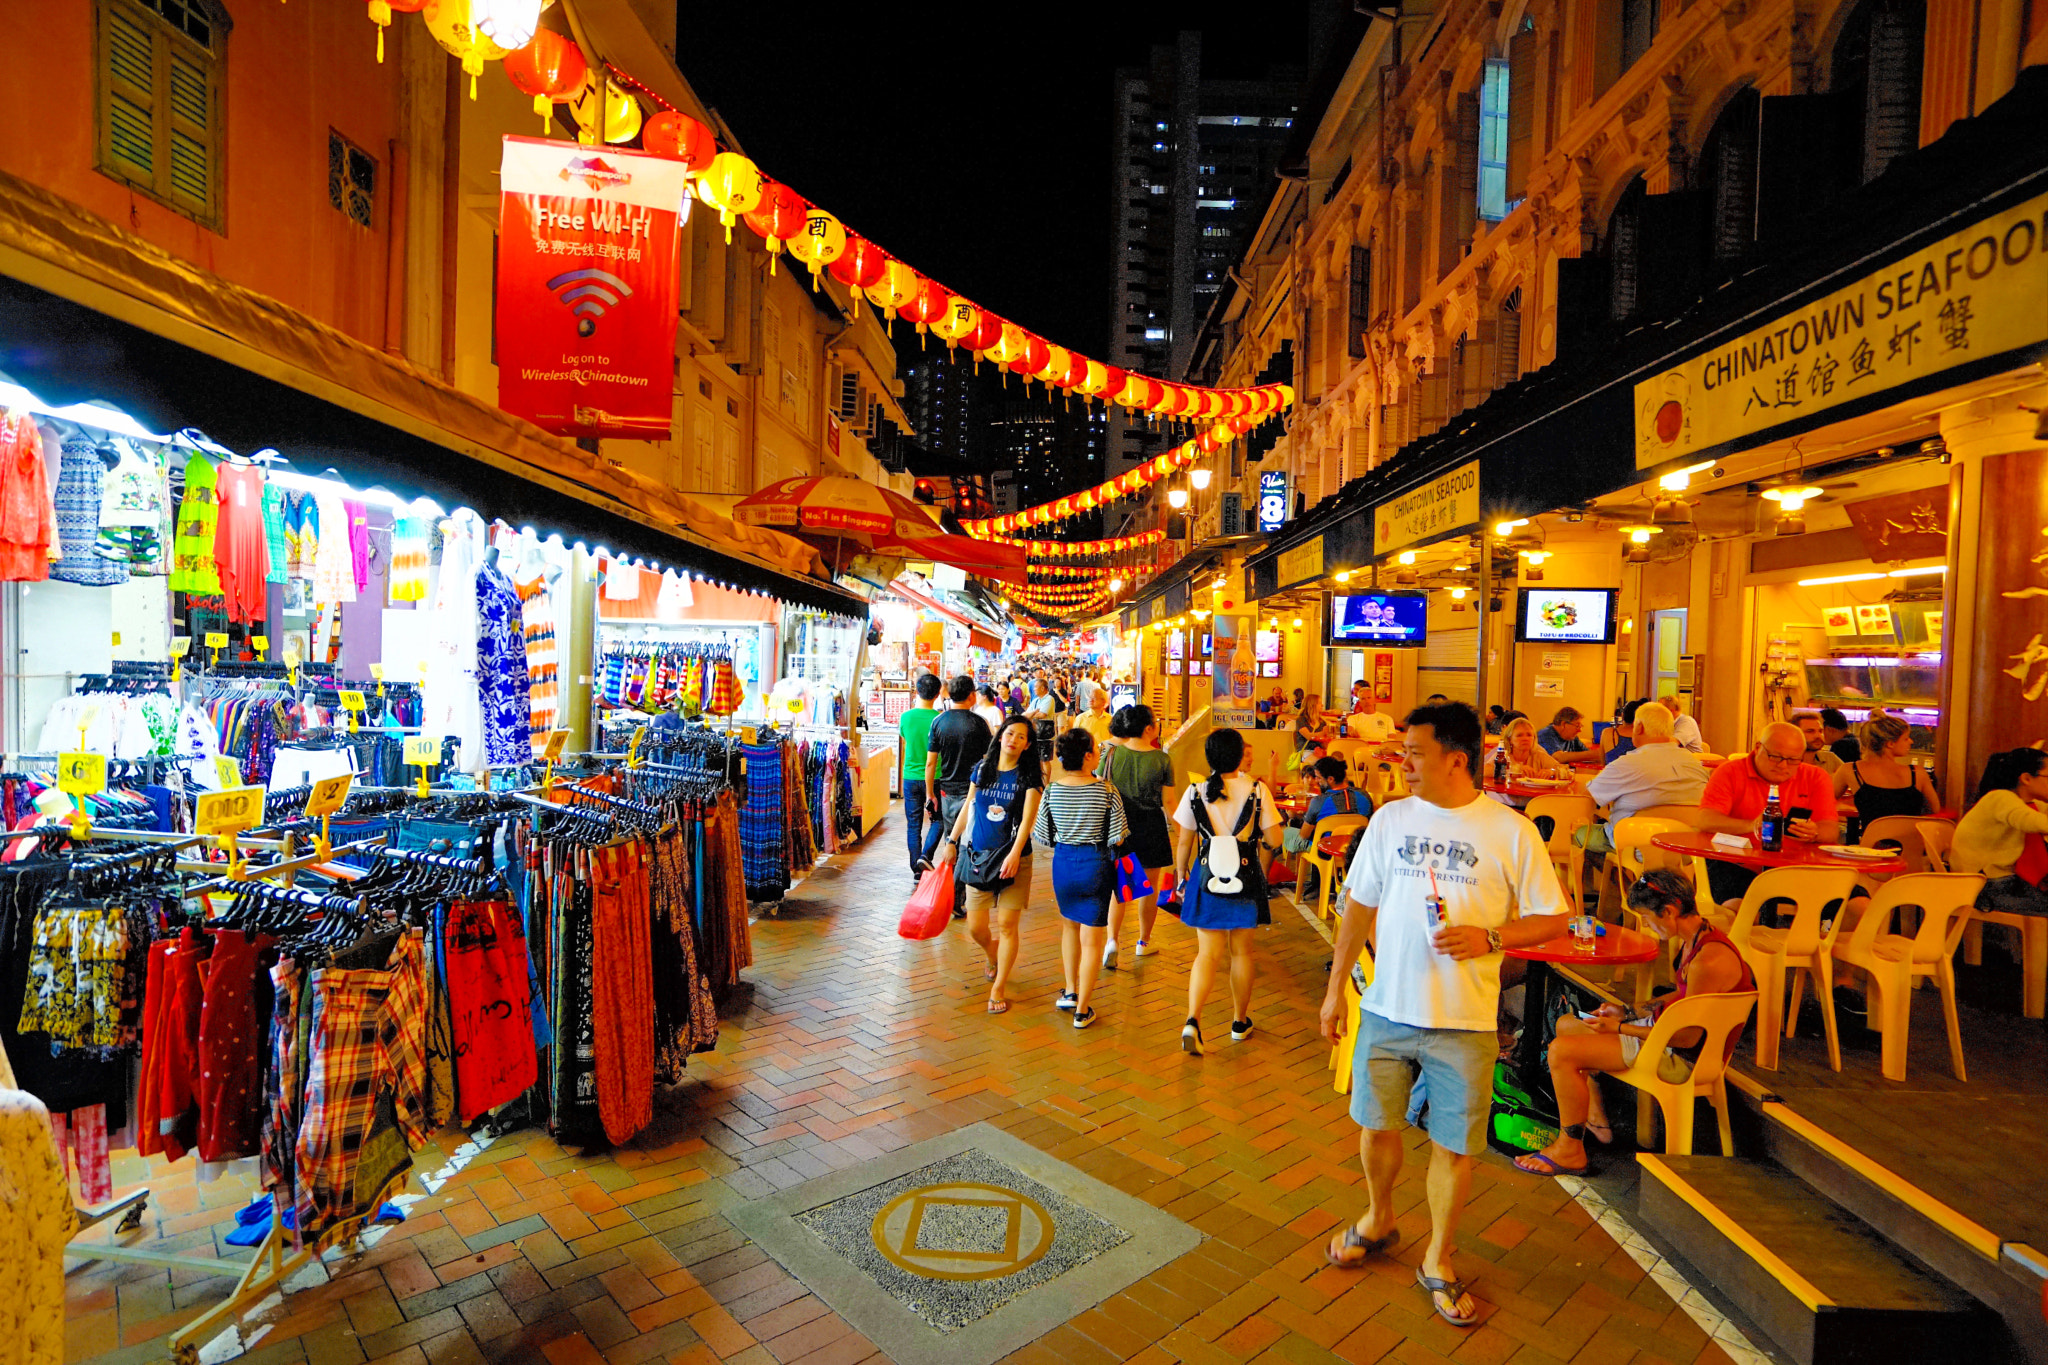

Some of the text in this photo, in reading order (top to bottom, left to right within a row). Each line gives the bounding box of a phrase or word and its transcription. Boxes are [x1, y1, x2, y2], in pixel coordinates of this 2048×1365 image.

[536, 207, 651, 239] Free Wi-Fi
[535, 238, 642, 264] 免费无线互联网
[1703, 210, 2048, 392] CHINATOWN SEAFOO
[562, 353, 610, 366] Log on to
[520, 367, 649, 387] Wireless@Chinatown
[1394, 470, 1475, 520] CHINATOWN SEAFOOD
[805, 511, 821, 520] No.
[823, 509, 829, 520] 1
[831, 513, 840, 522] in
[841, 514, 888, 530] Singapore
[411, 740, 433, 755] $10
[1394, 867, 1480, 887] UTILITY PRESTIGE
